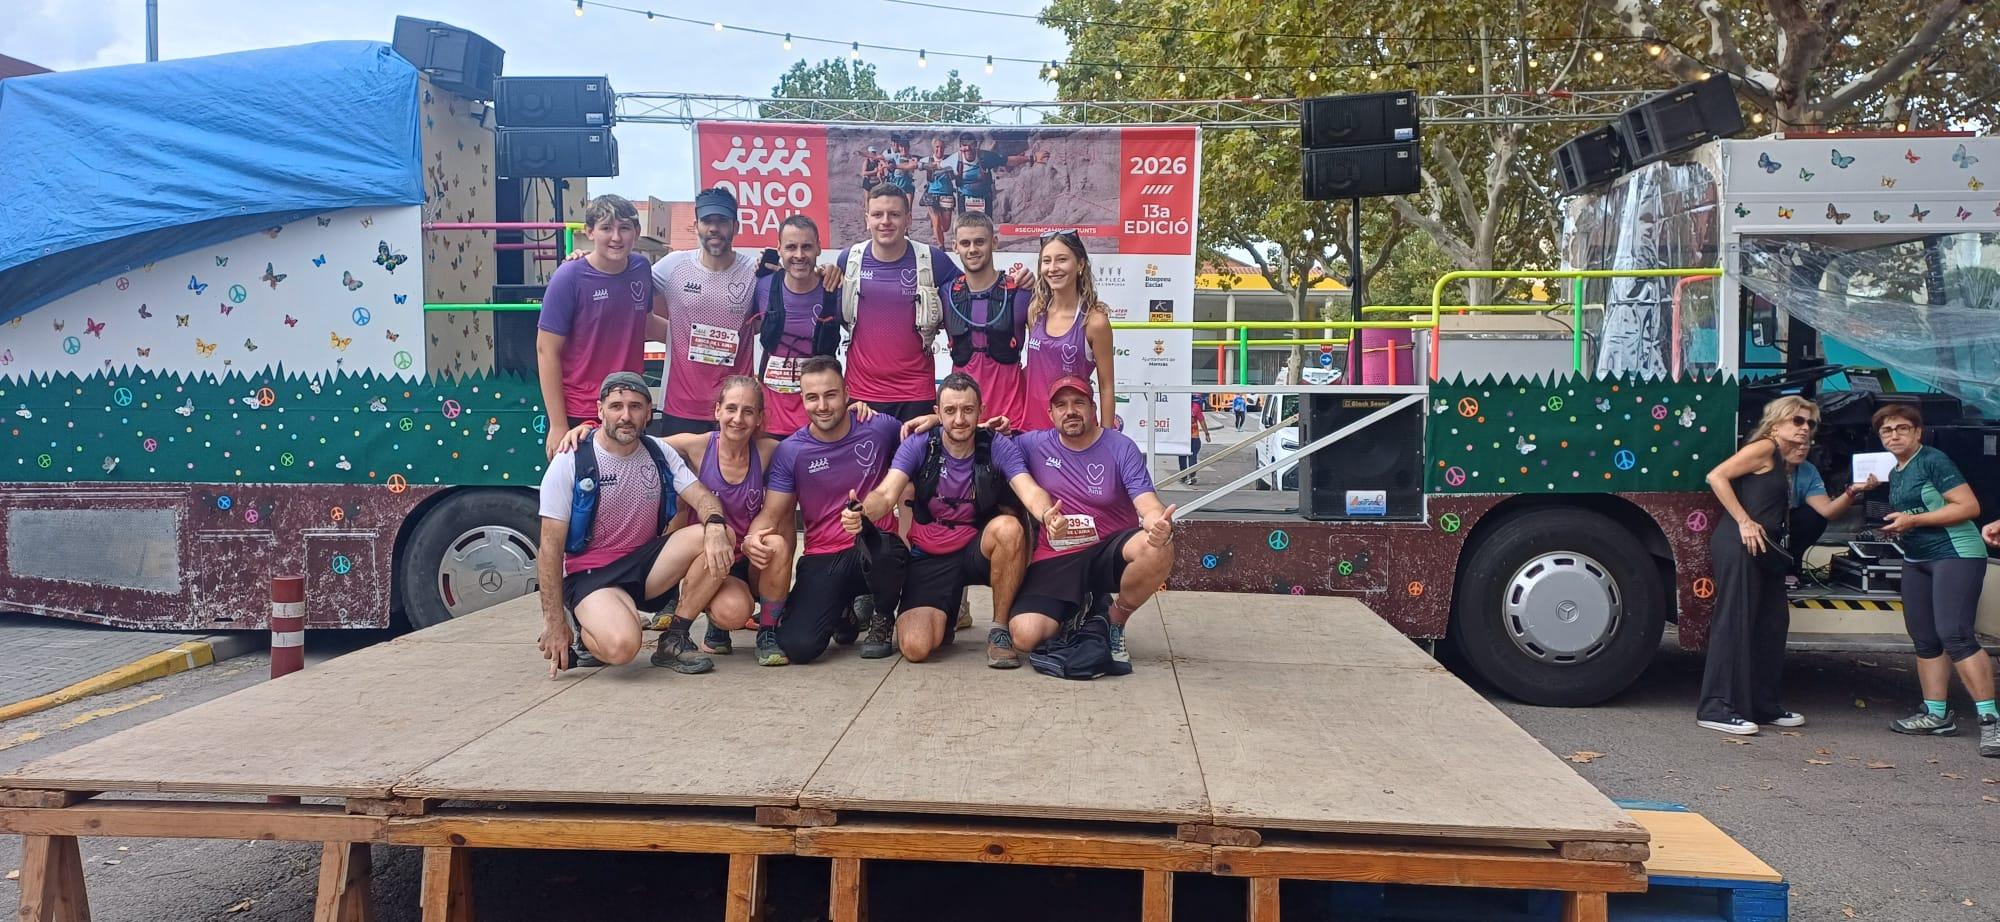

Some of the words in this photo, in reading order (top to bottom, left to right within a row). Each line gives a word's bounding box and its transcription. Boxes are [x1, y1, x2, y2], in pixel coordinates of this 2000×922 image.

[1130, 156, 1187, 175] 2026
[1142, 204, 1171, 218] 13a
[1124, 217, 1189, 235] EDICIÓ
[709, 329, 736, 342] 239-7
[1065, 518, 1090, 527] 39-3
